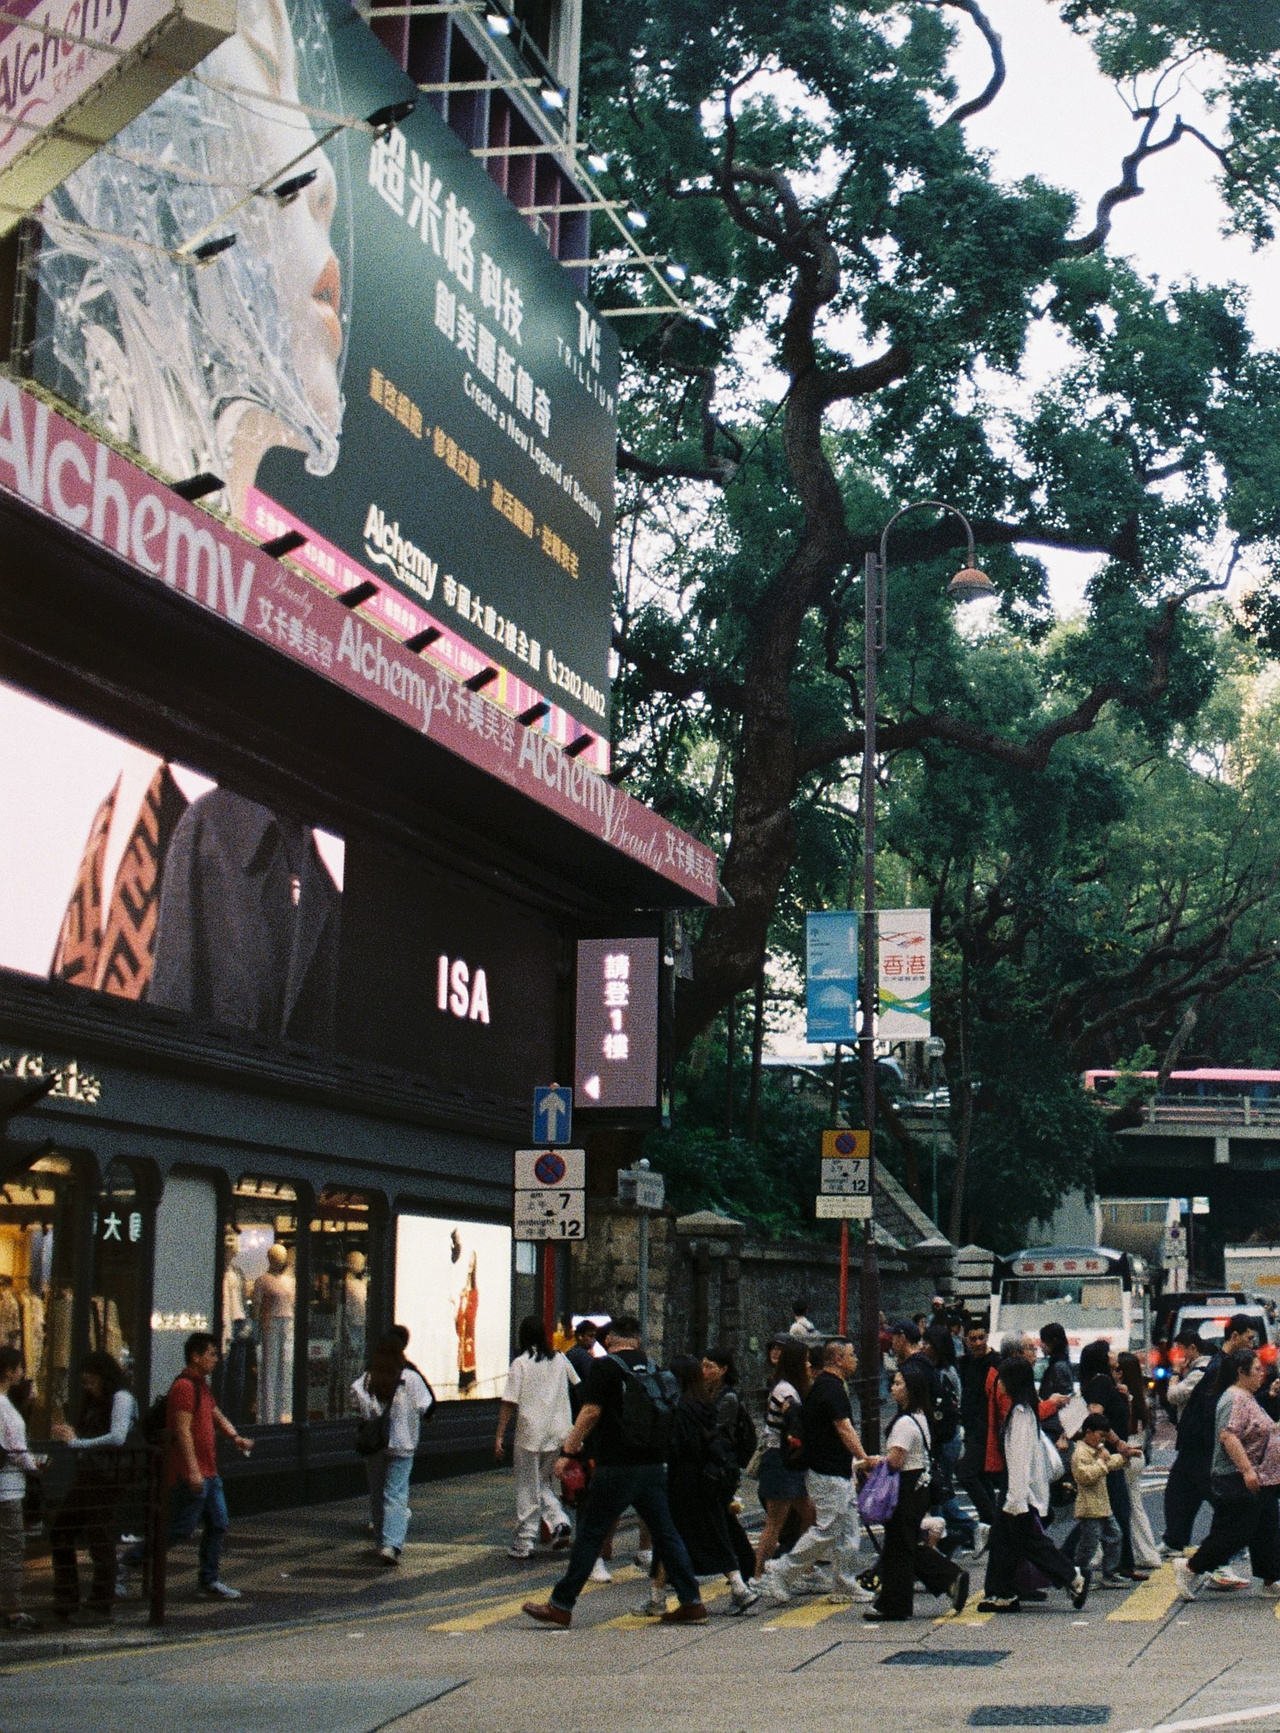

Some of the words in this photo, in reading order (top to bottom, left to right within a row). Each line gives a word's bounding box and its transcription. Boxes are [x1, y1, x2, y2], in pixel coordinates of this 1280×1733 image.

[463, 372, 498, 421] Create
[507, 414, 528, 451] New
[529, 437, 562, 485] Legend
[562, 474, 573, 494] of
[573, 481, 601, 528] Beauty
[0, 376, 255, 626] Alchemy
[363, 503, 438, 600] Alchemy
[337, 616, 435, 734] Alchemy
[518, 728, 616, 842] Alchemy
[438, 954, 490, 1025] ISA
[882, 954, 927, 975] 香港
[559, 1192, 571, 1209] 7
[851, 1179, 867, 1192] 12
[560, 1219, 581, 1237] 12
